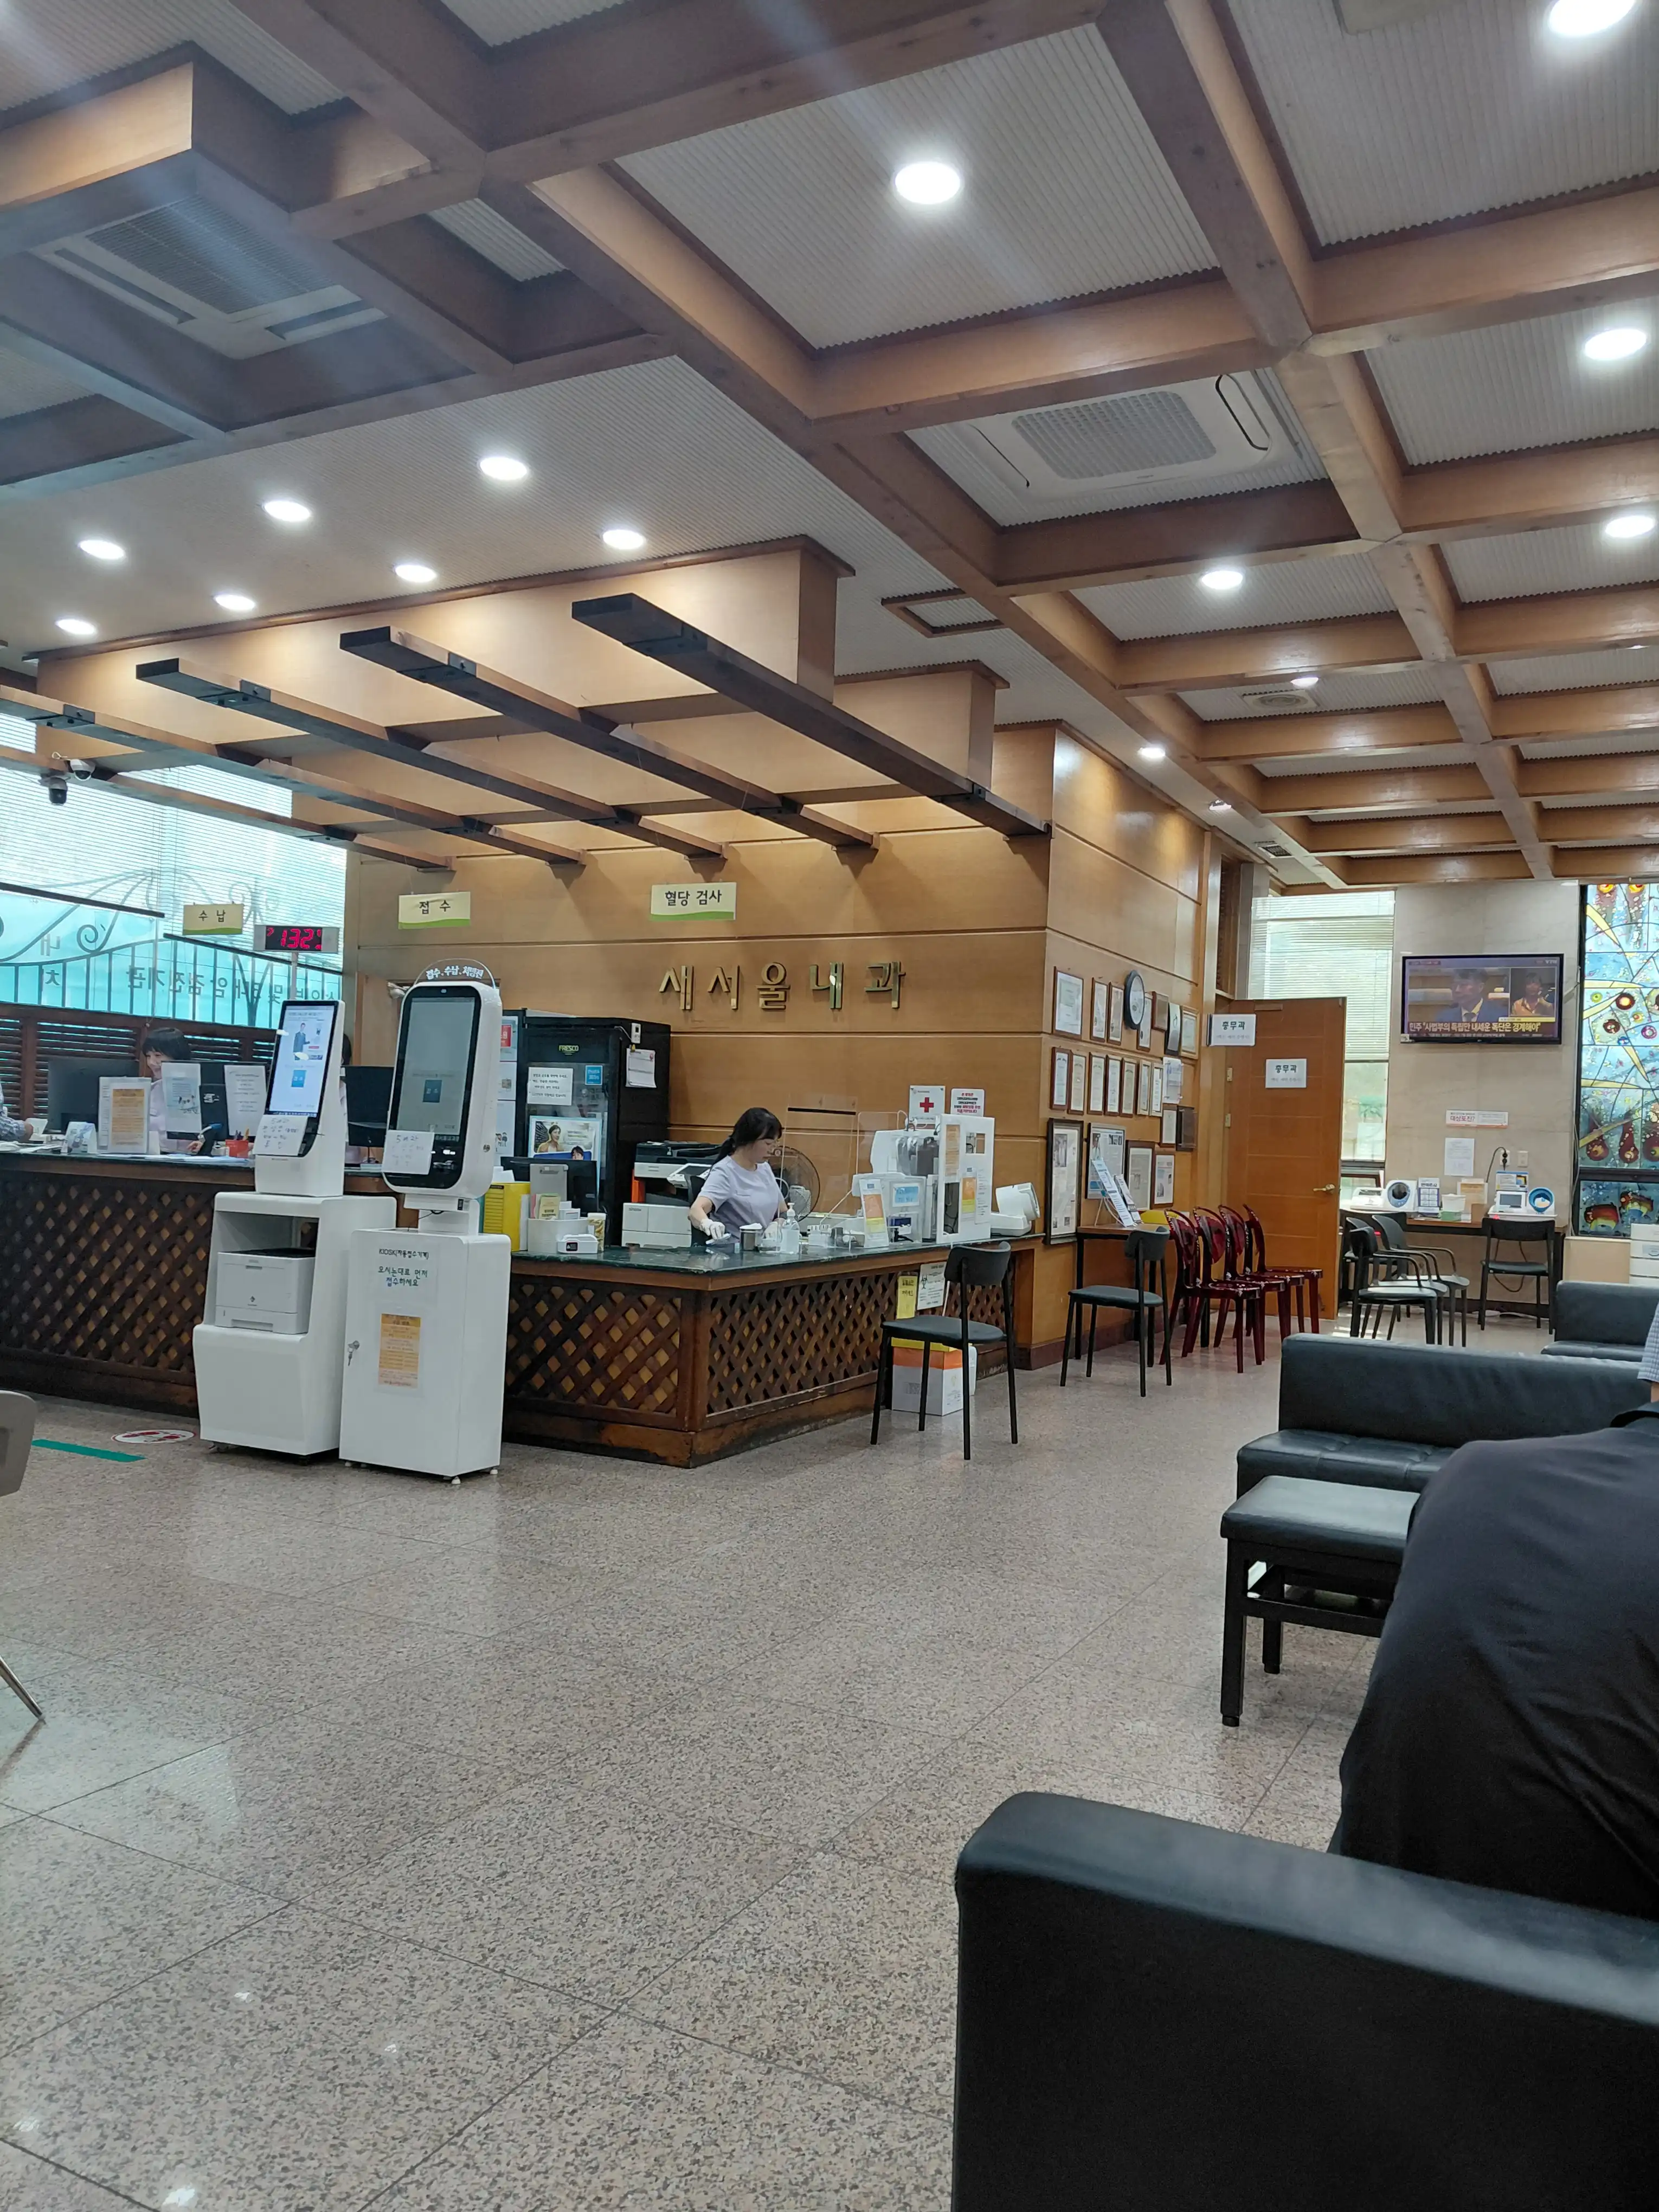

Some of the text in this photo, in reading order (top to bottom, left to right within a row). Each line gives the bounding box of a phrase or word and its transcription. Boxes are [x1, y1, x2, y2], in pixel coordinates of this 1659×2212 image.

[665, 890, 722, 906] 혈당 검사
[659, 961, 906, 1011] 새서울내과
[1222, 1021, 1245, 1031] 총무과
[1410, 1022, 1422, 1032] 민주
[1492, 1023, 1512, 1032] 독단은
[1275, 1065, 1297, 1073] 총무과
[378, 1266, 428, 1279] 오시는대로 먼저
[386, 1277, 419, 1287] 접수하세요
